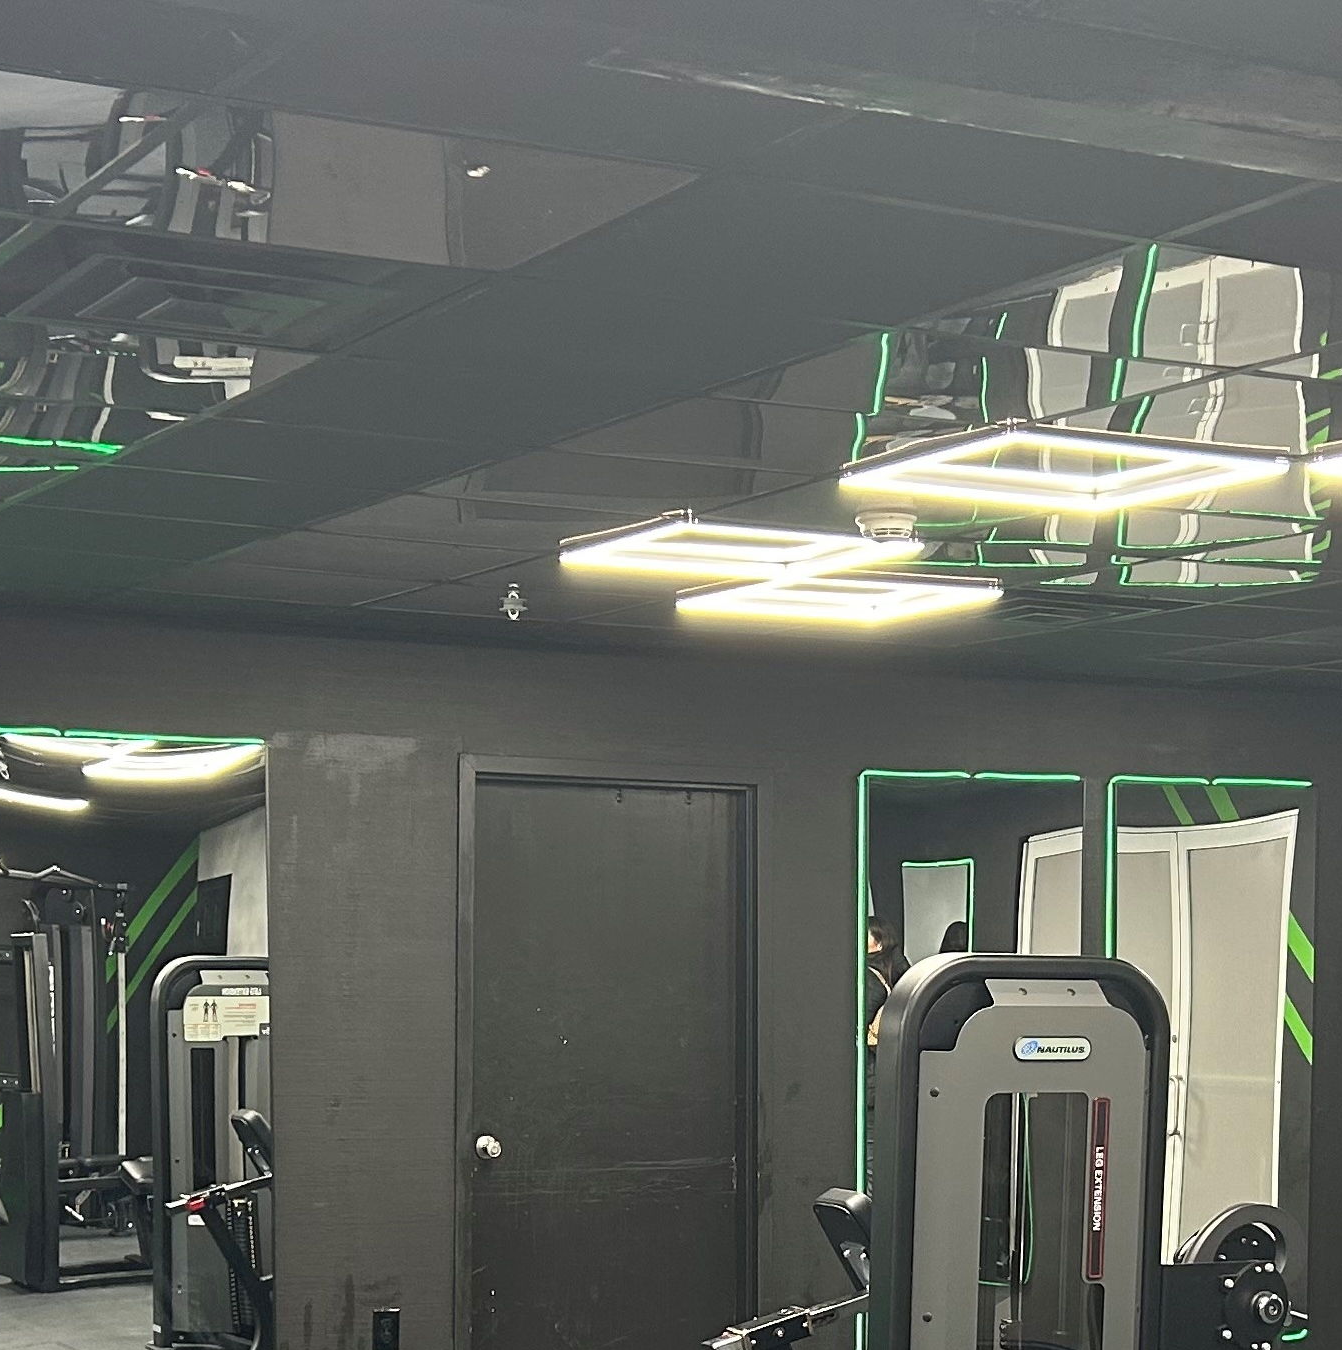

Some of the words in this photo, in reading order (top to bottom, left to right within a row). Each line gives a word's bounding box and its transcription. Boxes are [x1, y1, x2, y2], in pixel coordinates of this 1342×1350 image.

[1036, 1045, 1086, 1054] NAUTILUS
[1095, 1146, 1104, 1168] LEG
[1092, 1169, 1103, 1232] EXTENSION
